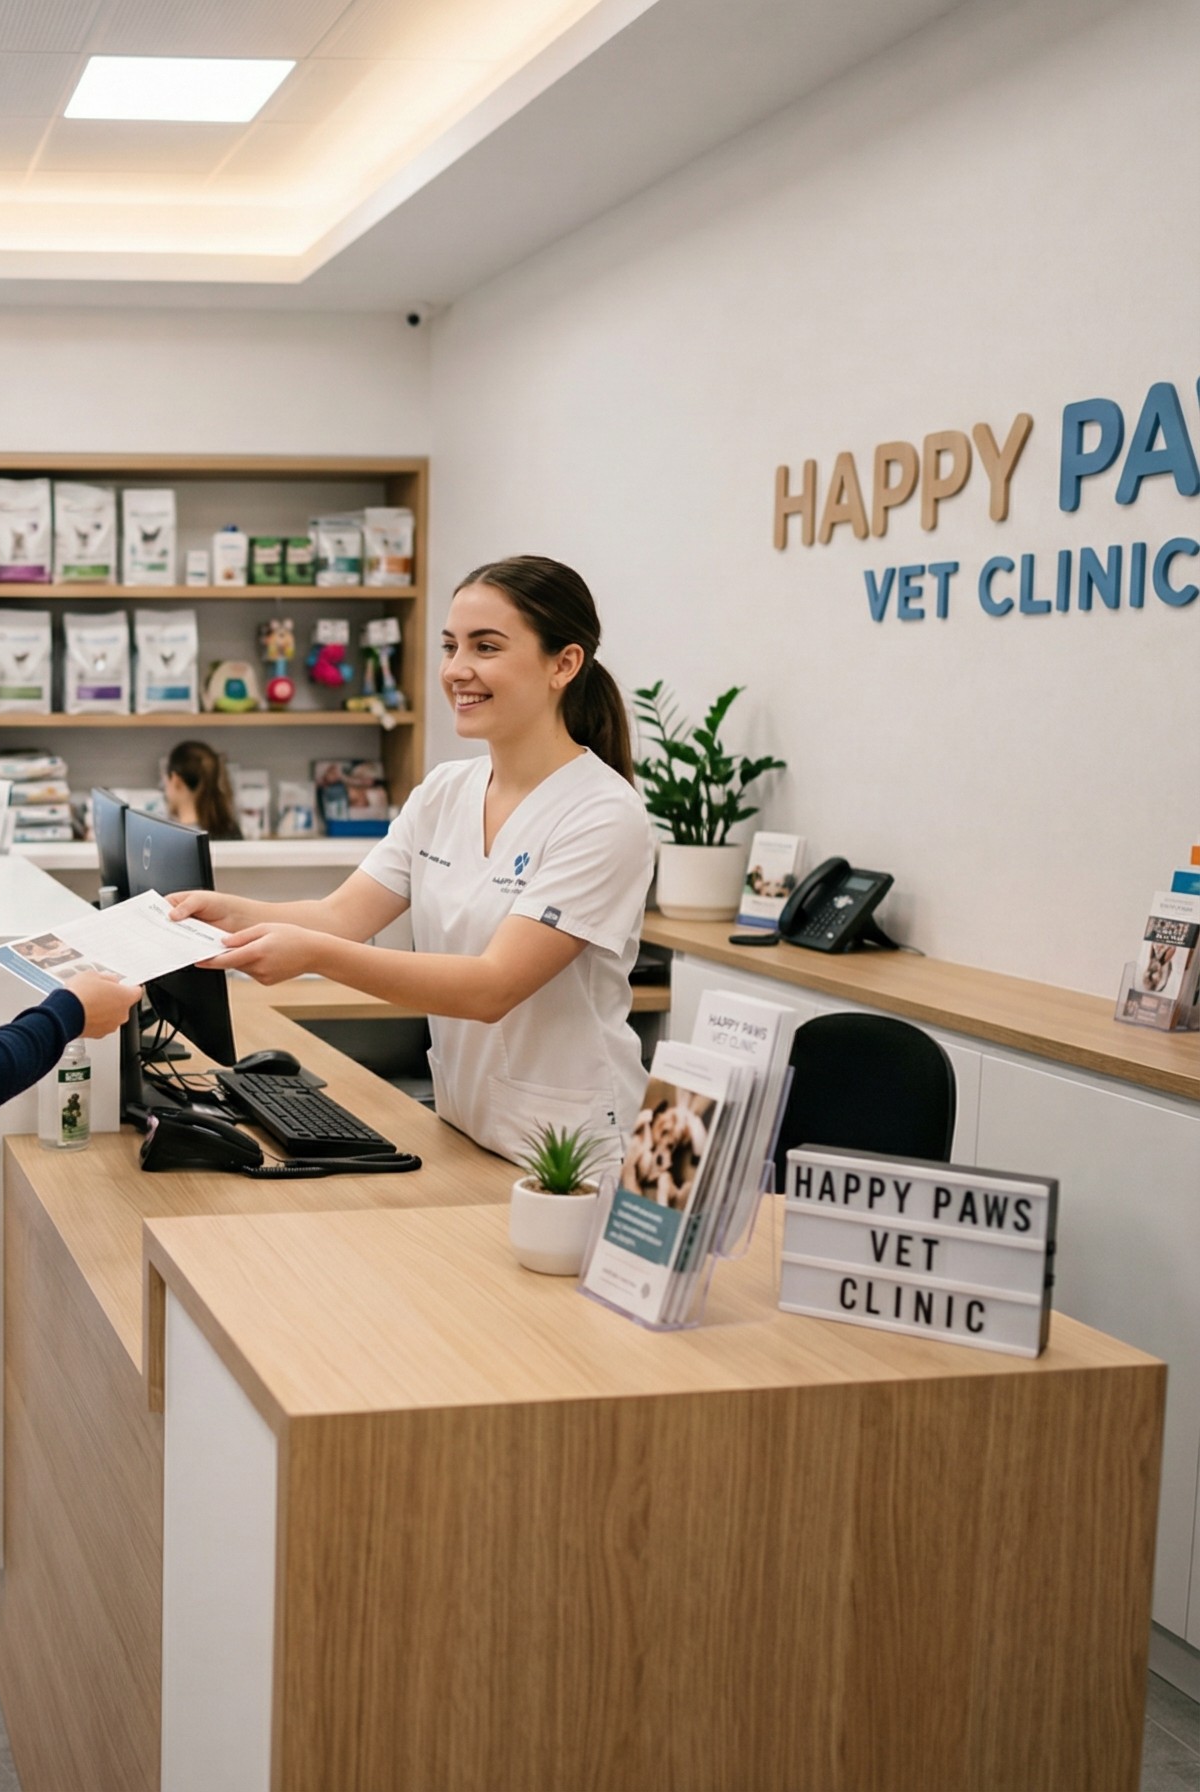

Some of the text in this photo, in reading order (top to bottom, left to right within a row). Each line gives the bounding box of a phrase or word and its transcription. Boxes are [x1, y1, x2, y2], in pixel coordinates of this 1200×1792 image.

[773, 376, 1200, 551] HAPPY PA
[864, 537, 1200, 623] VET CLINIC
[795, 1165, 1032, 1233] HAPPY PAWS
[870, 1229, 940, 1271] VET
[839, 1277, 986, 1333] CLINIC
